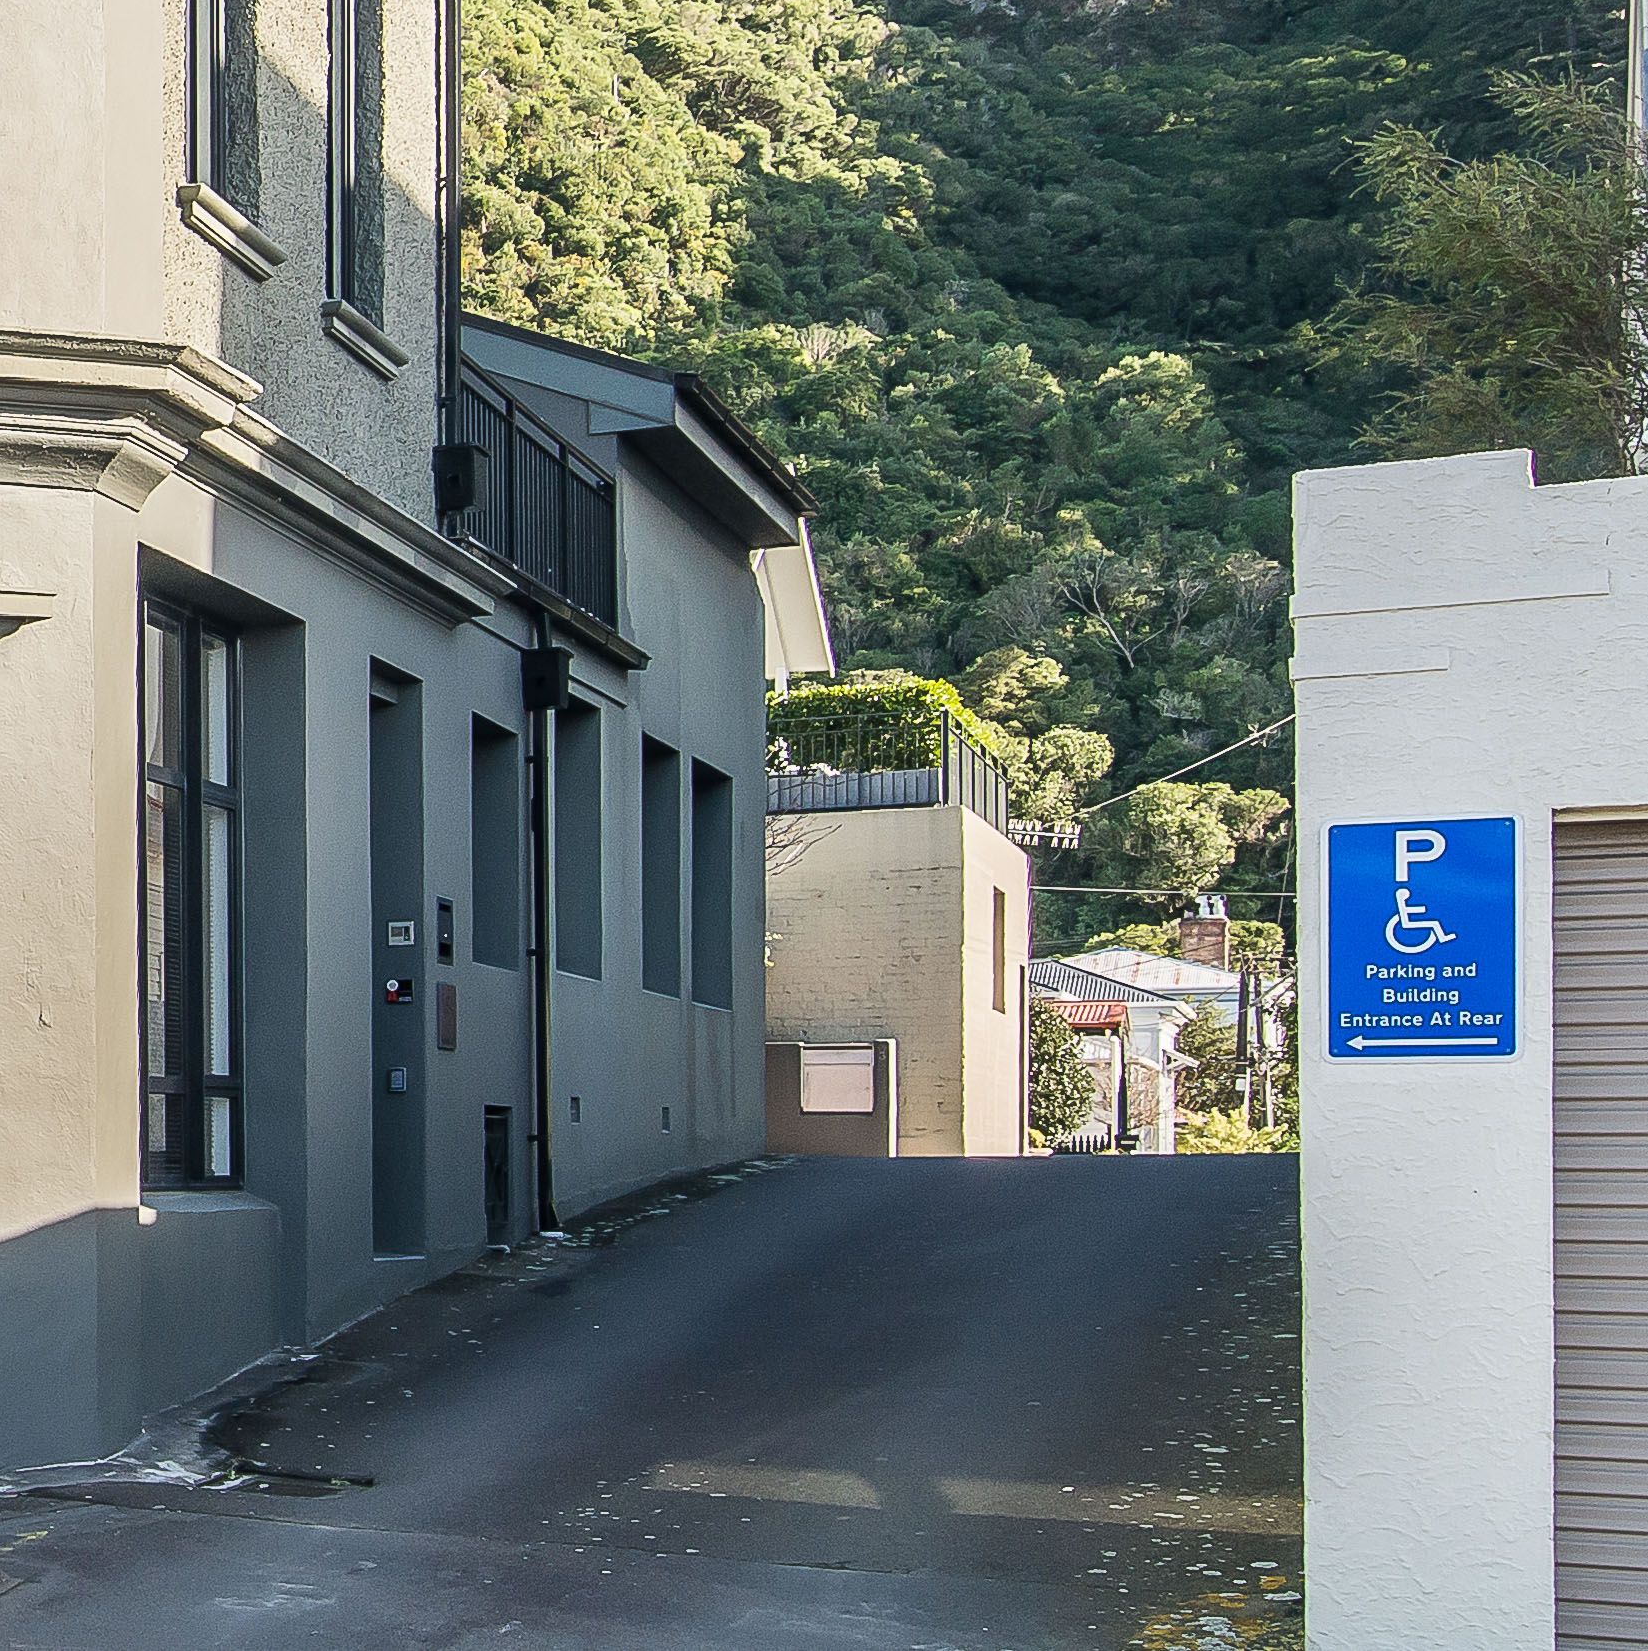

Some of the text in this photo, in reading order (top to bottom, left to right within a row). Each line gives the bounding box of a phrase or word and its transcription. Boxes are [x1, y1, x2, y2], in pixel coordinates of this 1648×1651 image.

[1395, 829, 1446, 882] P
[1366, 962, 1477, 981] Parking and
[1382, 988, 1460, 1005] Building
[1340, 1011, 1504, 1028] Entrance At Rear
